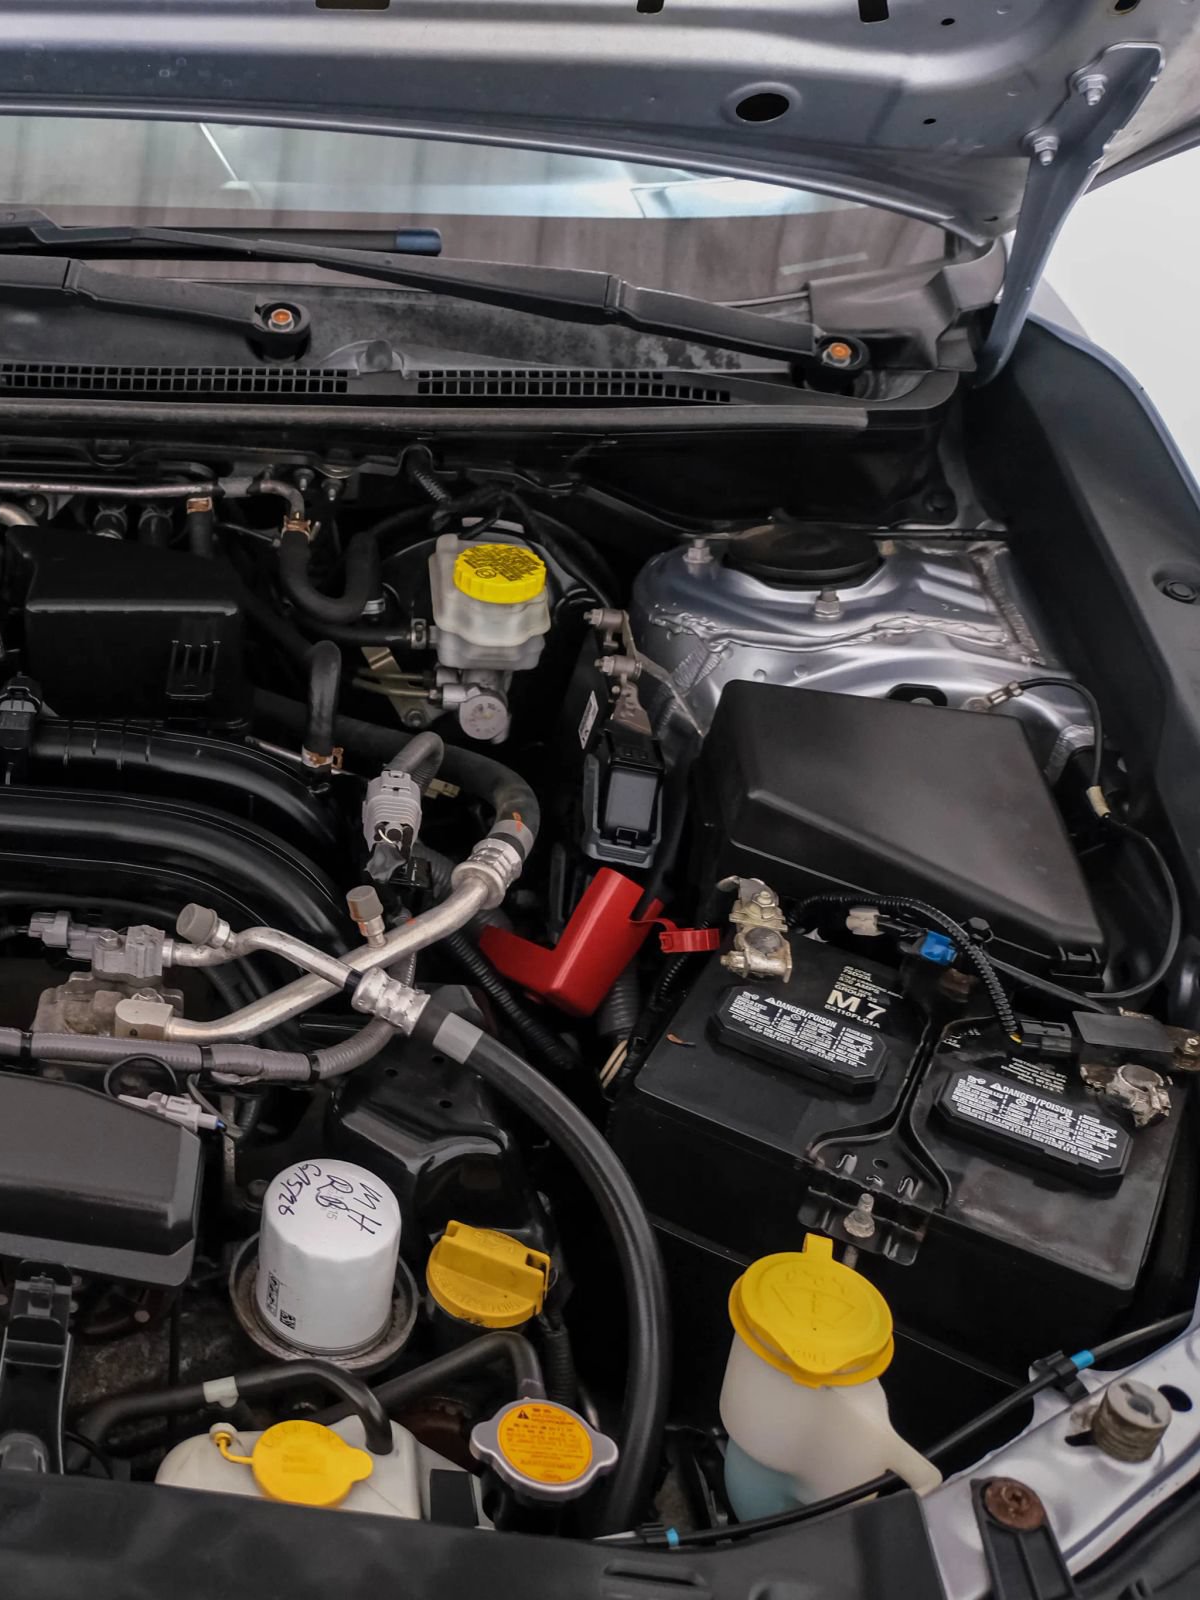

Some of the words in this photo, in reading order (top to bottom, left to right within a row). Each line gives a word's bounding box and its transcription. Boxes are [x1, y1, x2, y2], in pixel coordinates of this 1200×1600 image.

[826, 990, 861, 1012] M
[867, 1003, 887, 1019] 7
[834, 985, 867, 998] GROUP
[775, 1000, 837, 1028] DANGER/POISON
[1002, 1086, 1073, 1116] DANGER/POISON
